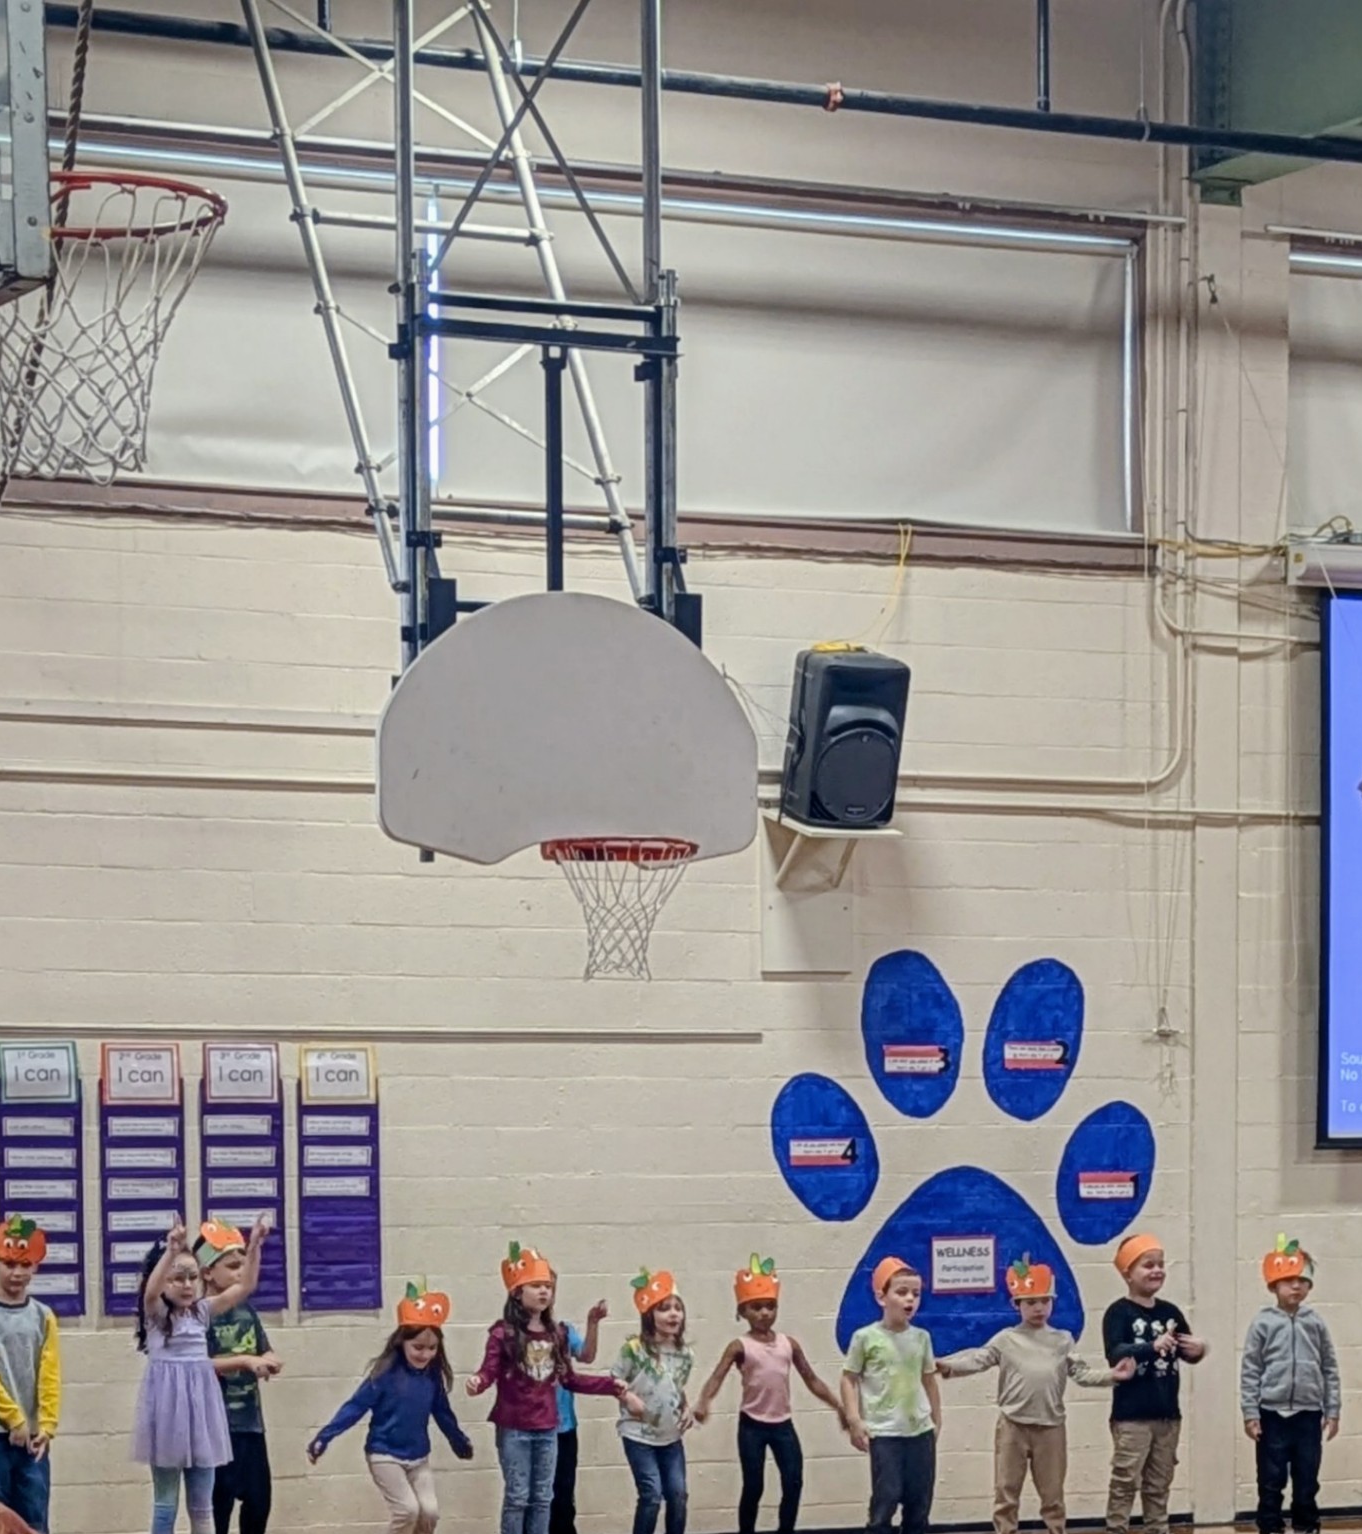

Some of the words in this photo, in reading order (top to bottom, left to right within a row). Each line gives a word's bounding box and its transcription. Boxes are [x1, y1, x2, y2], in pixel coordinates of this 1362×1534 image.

[28, 1050, 56, 1059] Grade
[135, 1052, 162, 1060] Grade
[234, 1052, 261, 1060] Grade
[938, 1046, 951, 1073] 3
[1055, 1040, 1070, 1066] 2
[24, 1068, 60, 1082] can
[128, 1068, 164, 1083] can
[228, 1068, 263, 1082] can
[326, 1068, 360, 1082] can
[1340, 1068, 1358, 1081] No
[1341, 1101, 1356, 1112] To
[841, 1136, 858, 1165] 4
[936, 1246, 990, 1258] WELLNESS
[941, 1264, 985, 1273] Participation
